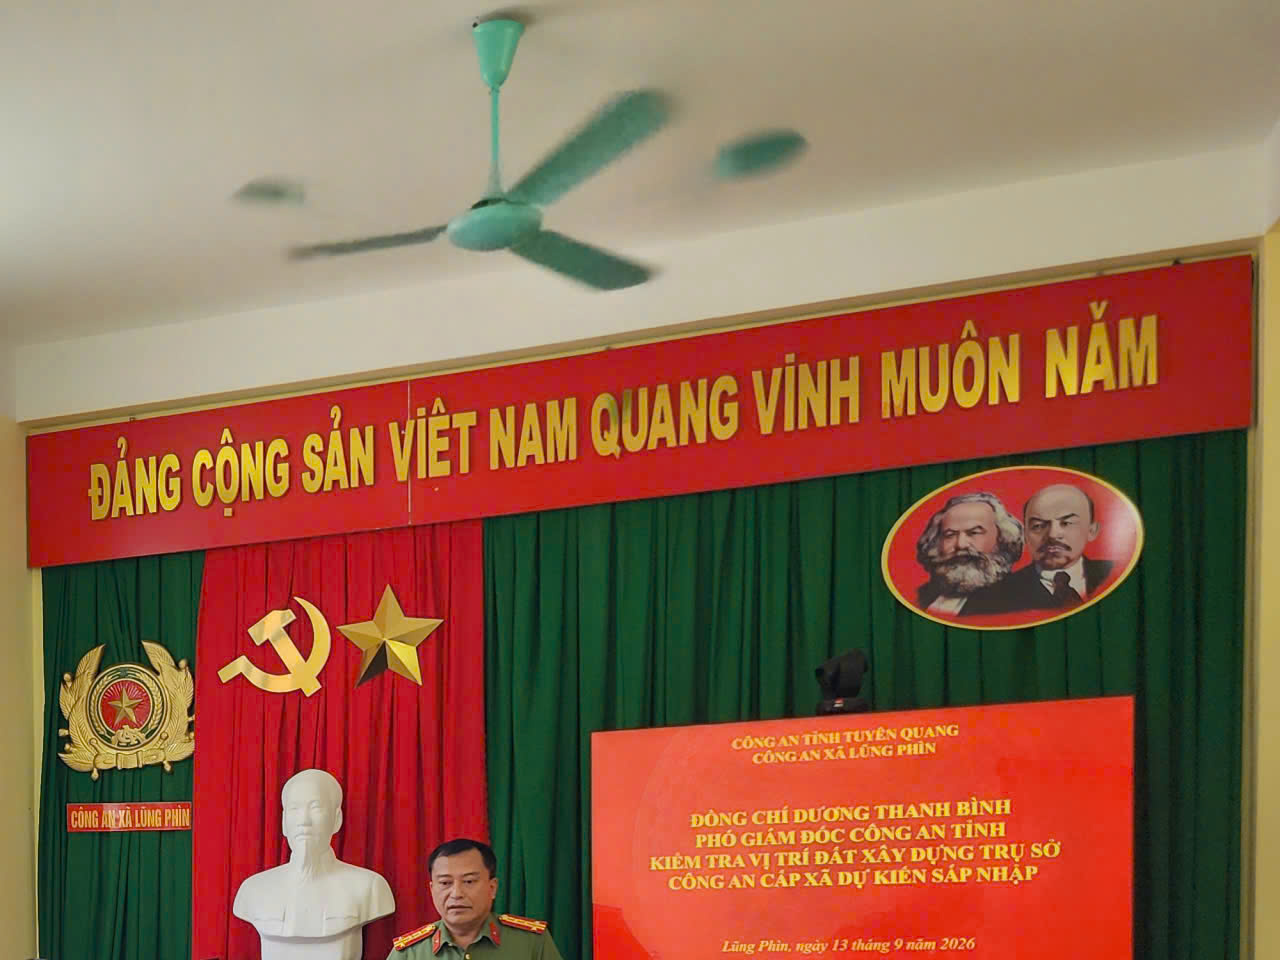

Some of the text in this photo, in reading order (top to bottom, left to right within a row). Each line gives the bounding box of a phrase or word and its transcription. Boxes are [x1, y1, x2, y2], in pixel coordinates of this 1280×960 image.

[88, 436, 181, 521] ĐẢNG
[192, 428, 289, 517] CỘNG
[301, 406, 374, 494] SẢN
[489, 397, 577, 470] NAM
[591, 374, 738, 458] QUANG
[881, 320, 1020, 419] MUÔN
[1045, 302, 1158, 399] NĂM
[731, 724, 960, 750] CÔNG AN TỈNH TUYÊN QUANG
[751, 741, 937, 765] CÔNG AN XÃ LŨNG PHÌN
[71, 806, 99, 829] CÔNG
[101, 809, 116, 829] AN
[135, 805, 162, 828] LŨNG
[164, 804, 191, 828] PHÌN
[690, 796, 1012, 828] ĐỒNG CHÍ DƯƠNG THANH BÌNH
[695, 819, 1006, 848] PHÓ GIÁM ĐỐC CÔNG AN TỈNH
[649, 838, 1062, 871] KIỂM TRA VỊ TRÍ ĐẤT XÂY DỰNG TRỤ SỞ
[668, 872, 725, 891] CÔNG
[727, 872, 756, 889] AN
[759, 869, 802, 889] CẤP
[802, 868, 833, 887] XÃ
[836, 867, 870, 890] DỰ
[871, 866, 928, 886] KIẾN
[975, 863, 1039, 886] NHẬP
[720, 939, 756, 956] Lũng
[795, 939, 829, 955] ngày
[831, 938, 850, 952] 13
[851, 937, 891, 954] tháng
[893, 938, 902, 952] 9
[905, 938, 937, 952] năm
[939, 937, 977, 951] 2026
